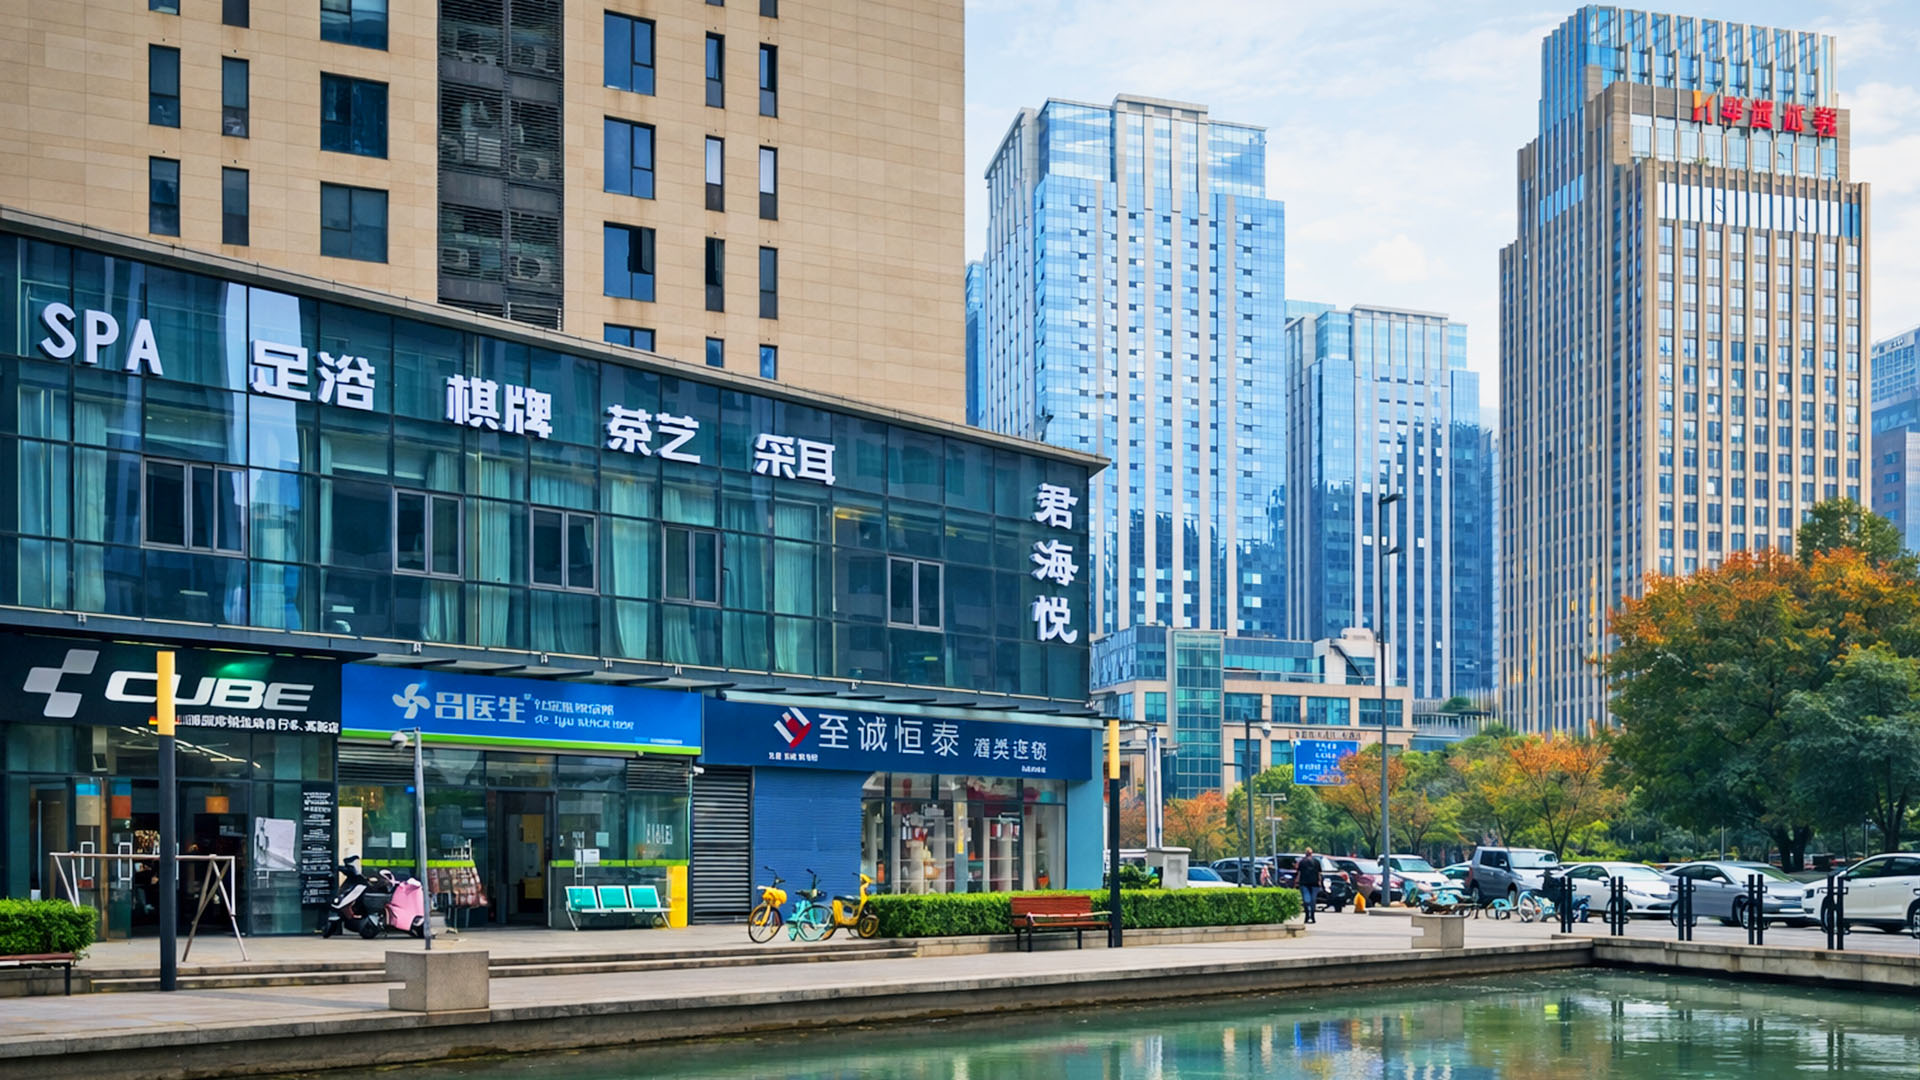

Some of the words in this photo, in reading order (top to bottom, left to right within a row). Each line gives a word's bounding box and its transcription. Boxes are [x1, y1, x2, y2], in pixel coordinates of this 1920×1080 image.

[40, 302, 164, 376] SPA
[446, 374, 553, 439] 棋牌
[606, 404, 701, 464] 茶艺
[1030, 483, 1079, 644] 君海悦
[105, 670, 314, 712] CUBE
[818, 713, 960, 757] 至诚恒泰
